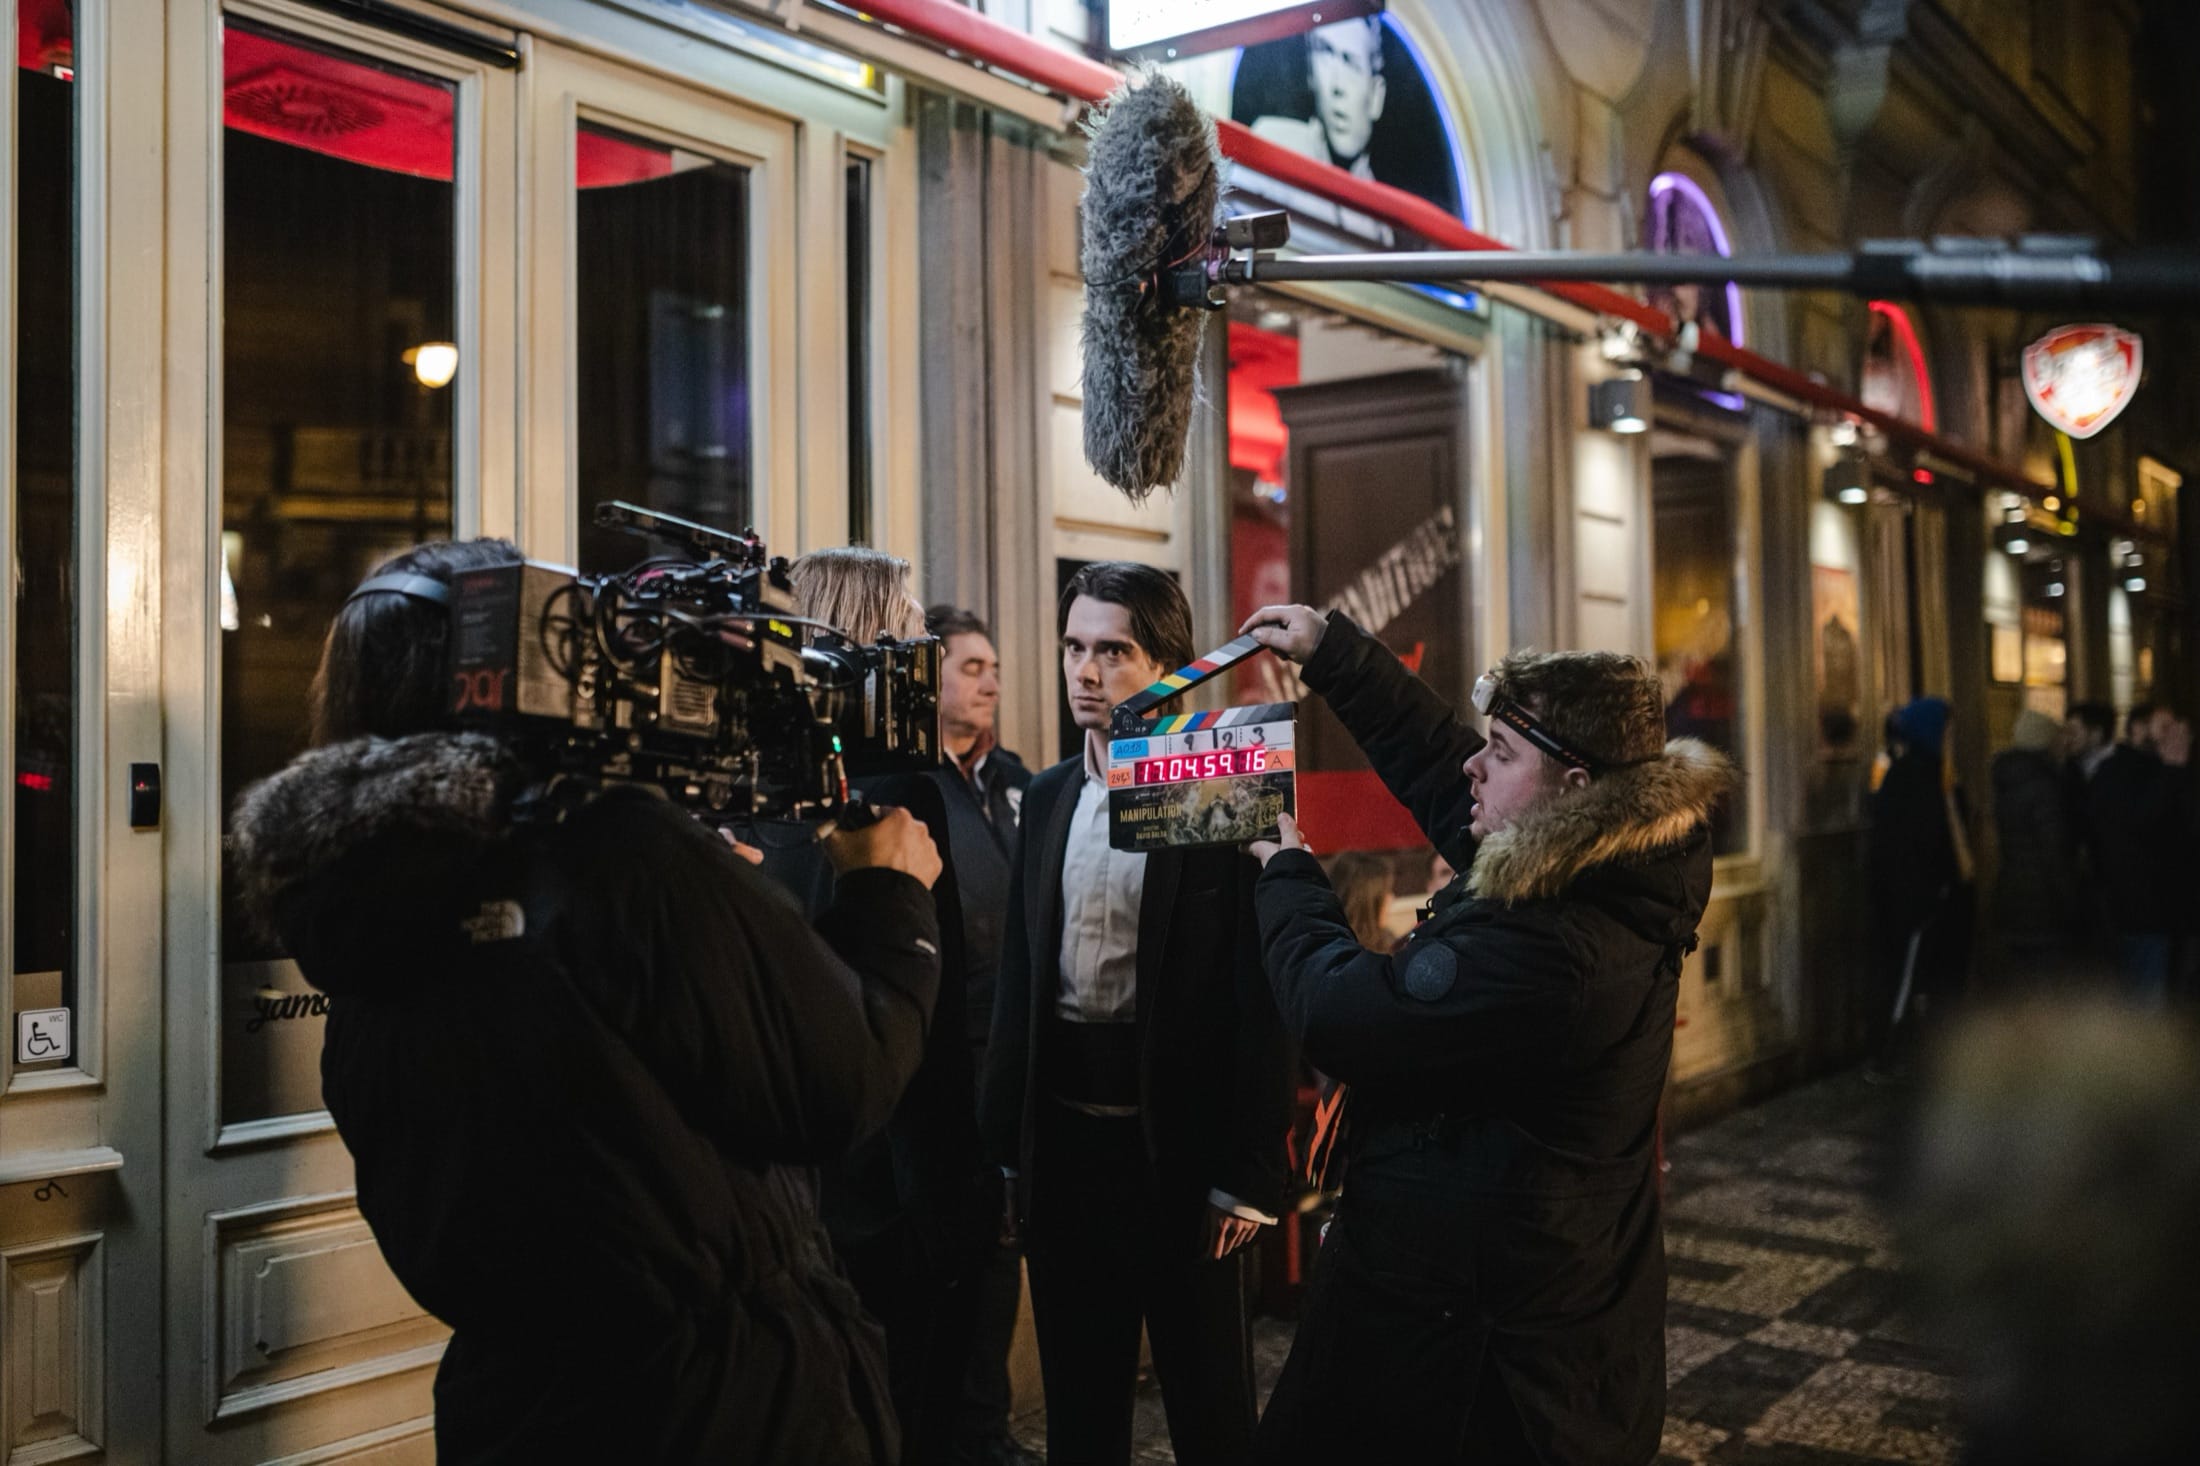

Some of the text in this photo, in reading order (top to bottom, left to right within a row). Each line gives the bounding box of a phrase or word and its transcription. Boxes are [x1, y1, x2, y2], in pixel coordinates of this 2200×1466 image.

[1184, 733, 1194, 751] 9
[1249, 726, 1265, 746] 3
[1271, 755, 1283, 768] A
[49, 1014, 64, 1022] WC
